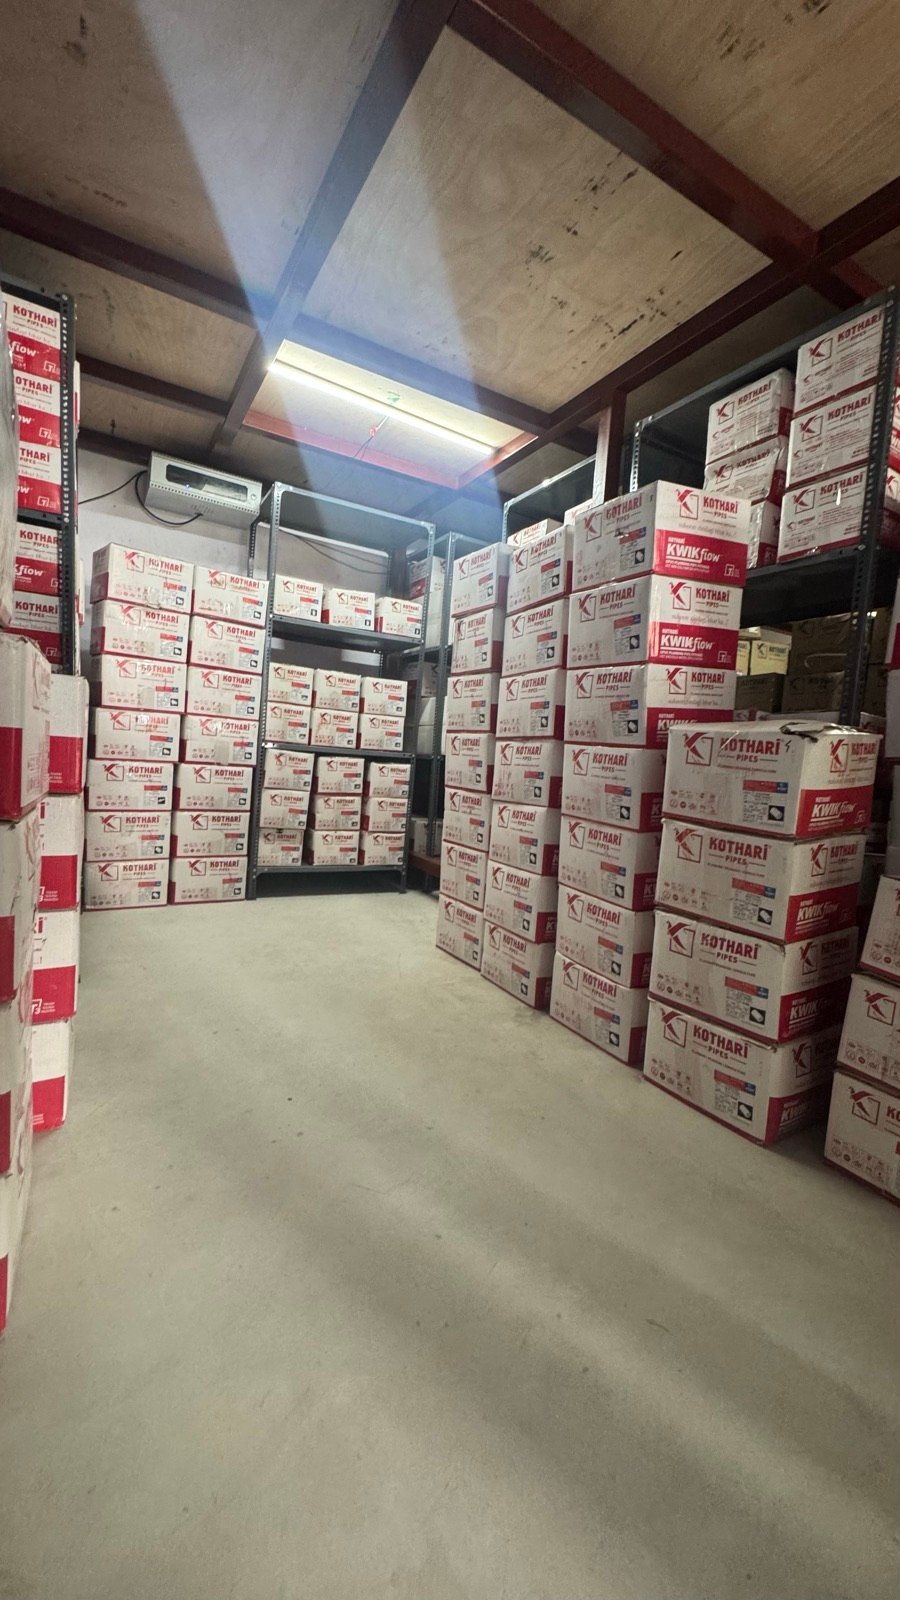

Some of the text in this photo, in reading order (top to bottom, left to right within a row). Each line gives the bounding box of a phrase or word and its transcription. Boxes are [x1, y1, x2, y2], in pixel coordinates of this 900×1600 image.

[15, 376, 52, 394] OTHARi
[20, 447, 50, 463] THARi
[19, 529, 59, 544] KOTHAR
[736, 754, 759, 763] PIPES
[725, 856, 747, 866] PIPES
[716, 952, 738, 964] PIPES
